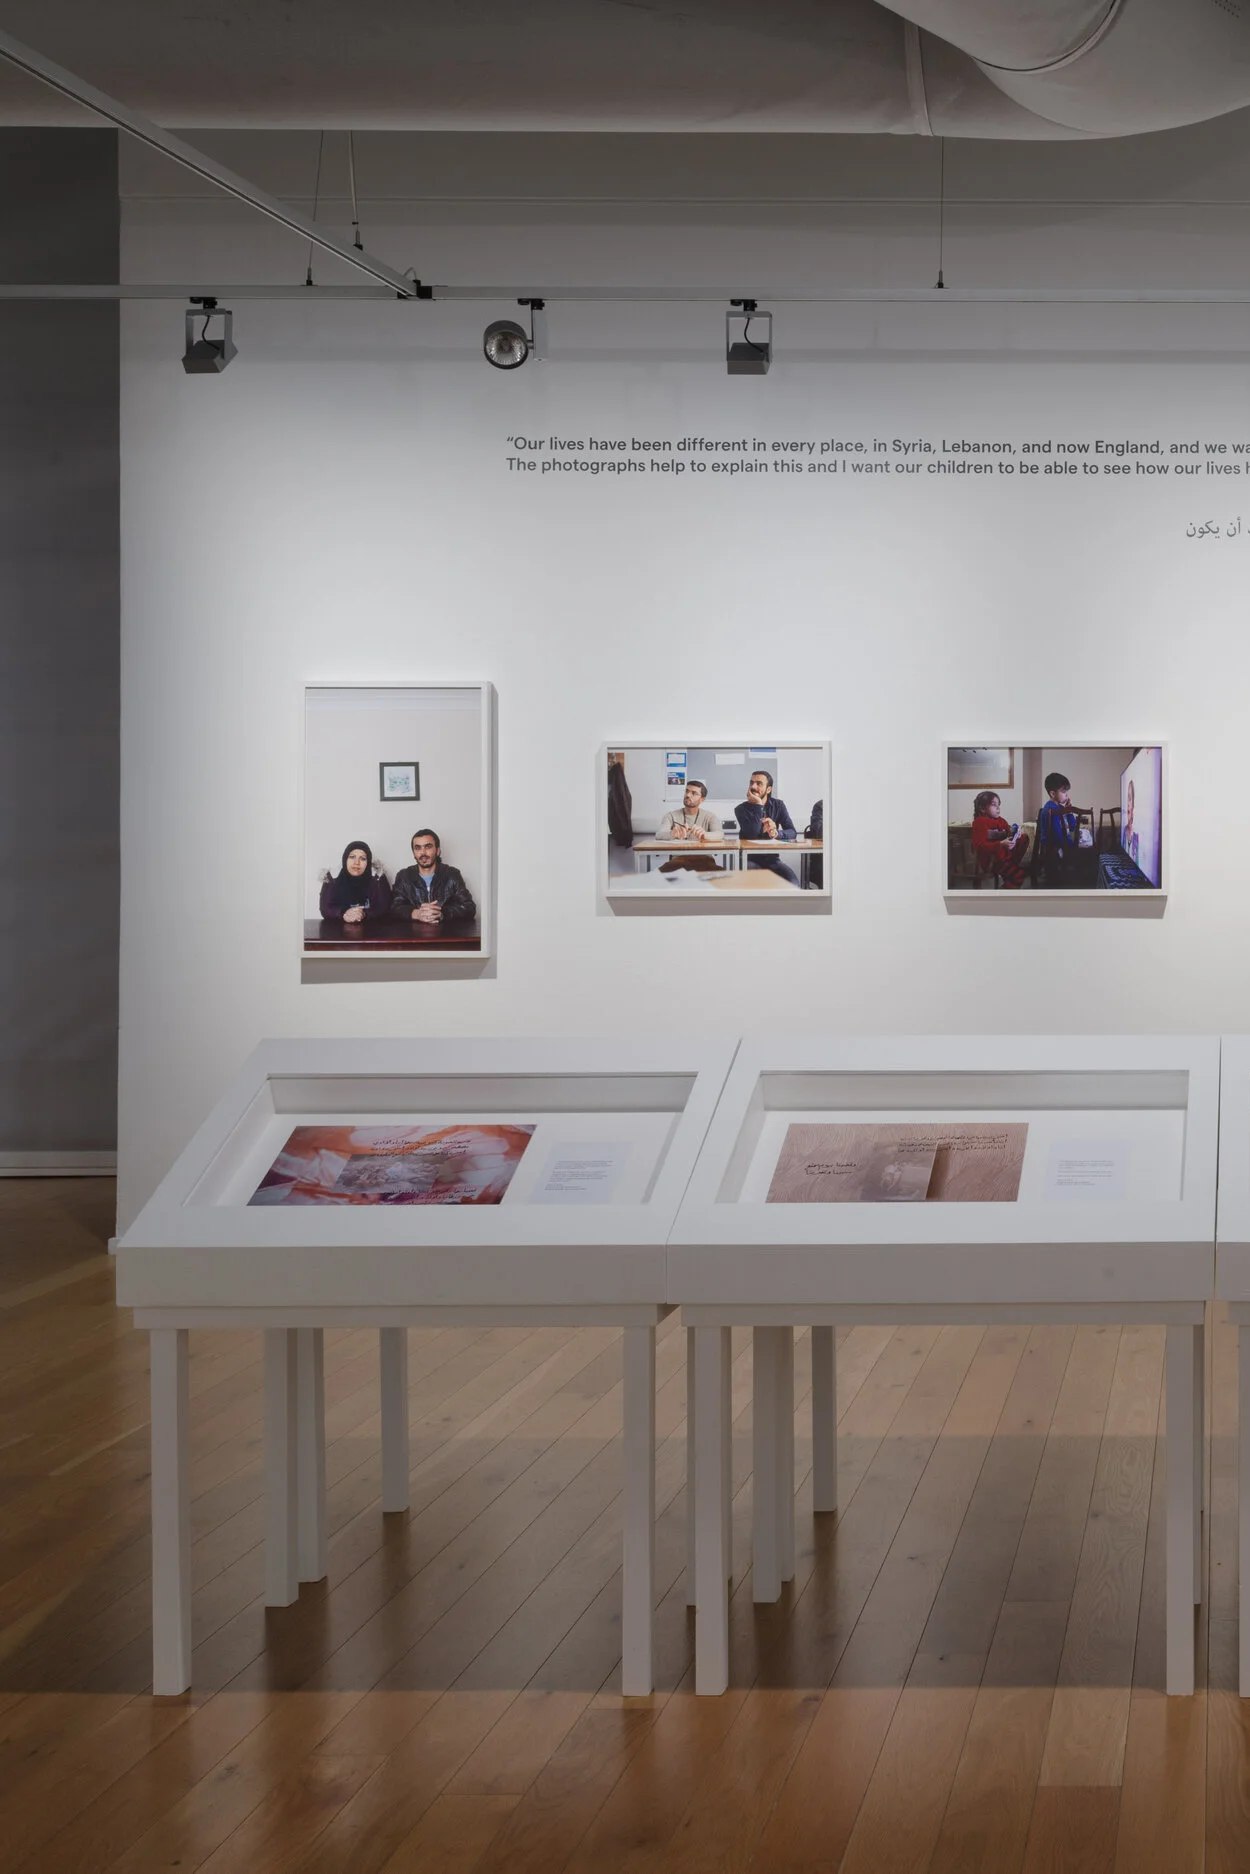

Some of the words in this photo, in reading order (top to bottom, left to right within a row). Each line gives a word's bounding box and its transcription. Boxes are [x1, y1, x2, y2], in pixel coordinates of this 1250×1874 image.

[549, 436, 585, 451] lives
[589, 436, 627, 451] have
[631, 437, 672, 452] been
[676, 437, 749, 452] different
[752, 437, 767, 452] in
[771, 441, 816, 456] every
[820, 438, 868, 456] place,
[873, 438, 888, 453] in
[891, 438, 937, 456] Syria,
[942, 439, 1017, 456] Lebanon,
[1021, 439, 1052, 454] and
[1056, 443, 1091, 454] now
[1094, 439, 1165, 457] England,
[1169, 440, 1200, 454] and
[1204, 443, 1228, 454] we
[505, 457, 537, 472] The
[541, 457, 646, 476] photographs
[650, 458, 686, 476] help
[689, 459, 707, 473] to
[710, 458, 769, 476] explain
[772, 458, 804, 473] this
[807, 459, 838, 473] and
[842, 459, 847, 473] I
[850, 460, 891, 474] want
[894, 463, 923, 474] our
[926, 459, 994, 475] children
[997, 461, 1015, 475] to
[1019, 460, 1040, 475] be
[1043, 460, 1079, 475] able
[1081, 461, 1100, 475] to
[1103, 464, 1132, 475] see
[1135, 460, 1170, 475] how
[1173, 464, 1203, 475] our
[1206, 460, 1241, 475] lives
[1185, 519, 1221, 540] يكون
[1226, 516, 1241, 538] أن
